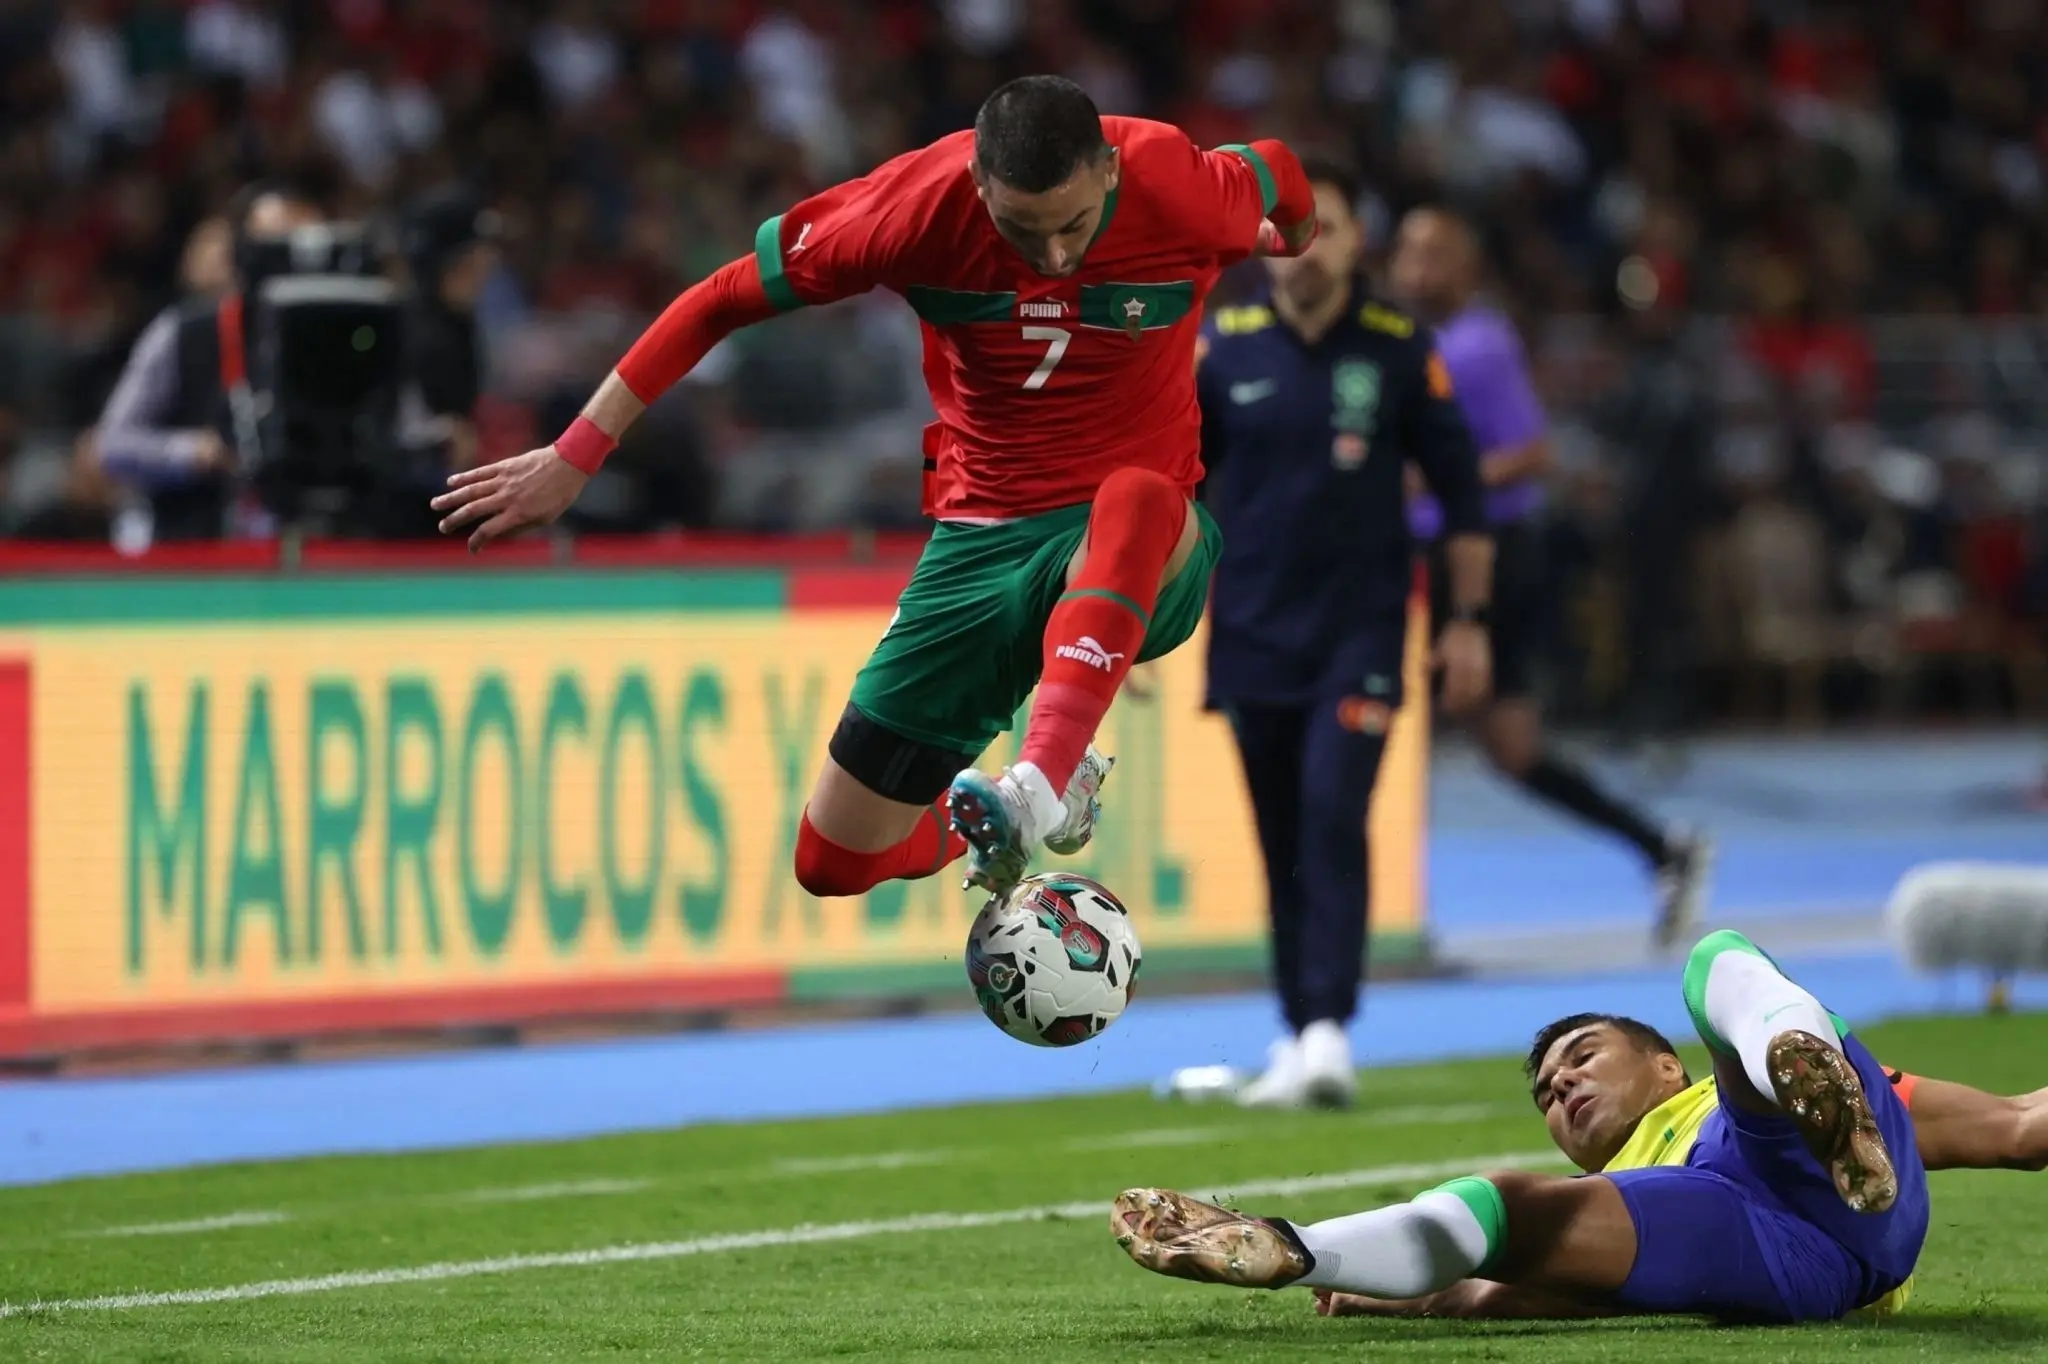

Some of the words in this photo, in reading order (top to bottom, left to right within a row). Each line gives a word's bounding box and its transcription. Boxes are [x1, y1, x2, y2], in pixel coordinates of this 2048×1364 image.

[1020, 303, 1061, 318] PUMA
[1022, 326, 1071, 389] 7
[1055, 645, 1104, 668] PUMA
[126, 664, 732, 975] MARROCOS
[762, 667, 826, 940] X
